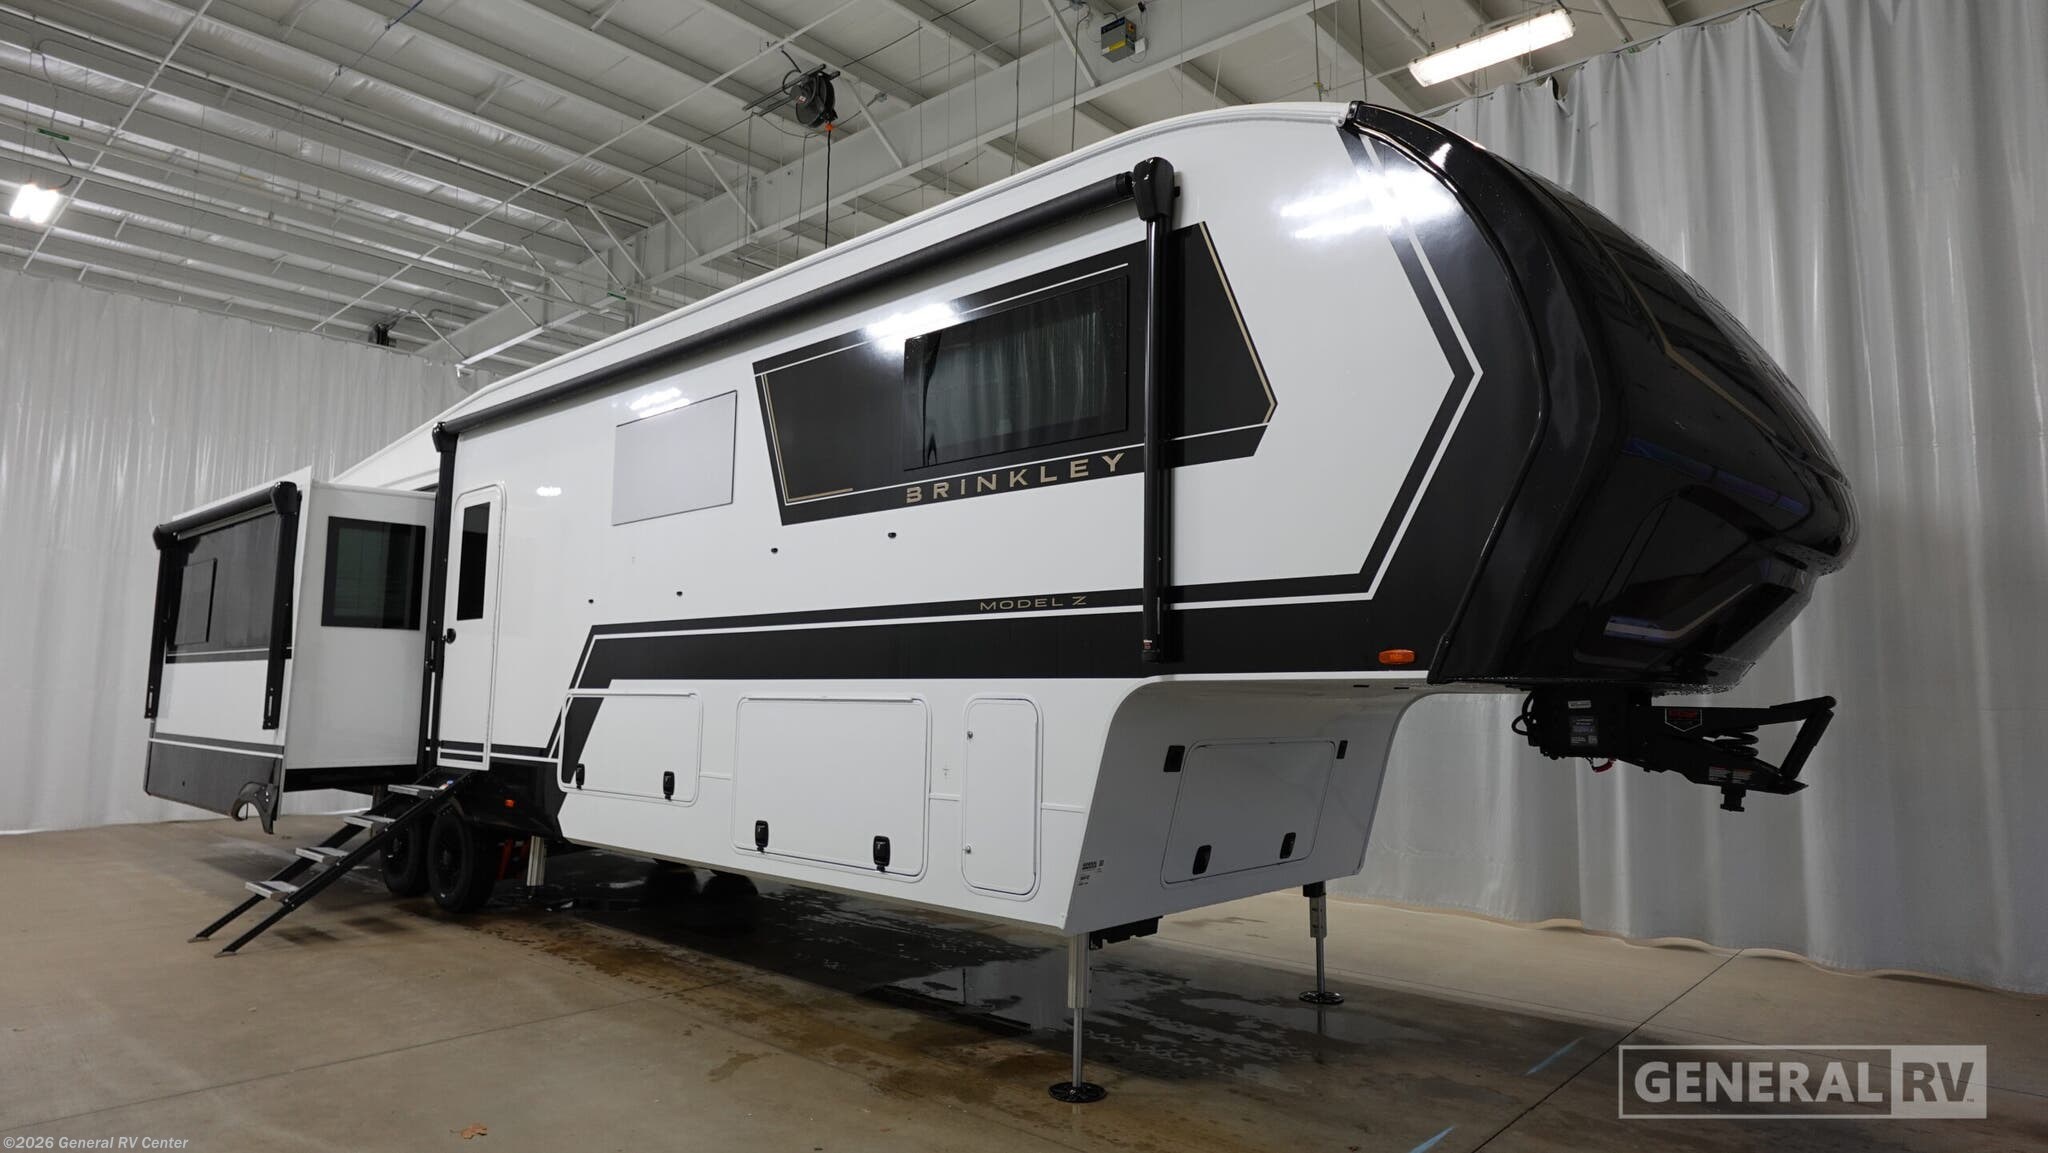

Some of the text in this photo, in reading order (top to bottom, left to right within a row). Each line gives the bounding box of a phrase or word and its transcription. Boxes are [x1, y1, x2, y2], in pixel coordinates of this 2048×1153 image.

[906, 452, 1125, 504] BRINKLEY
[980, 596, 1087, 611] MODEL Z
